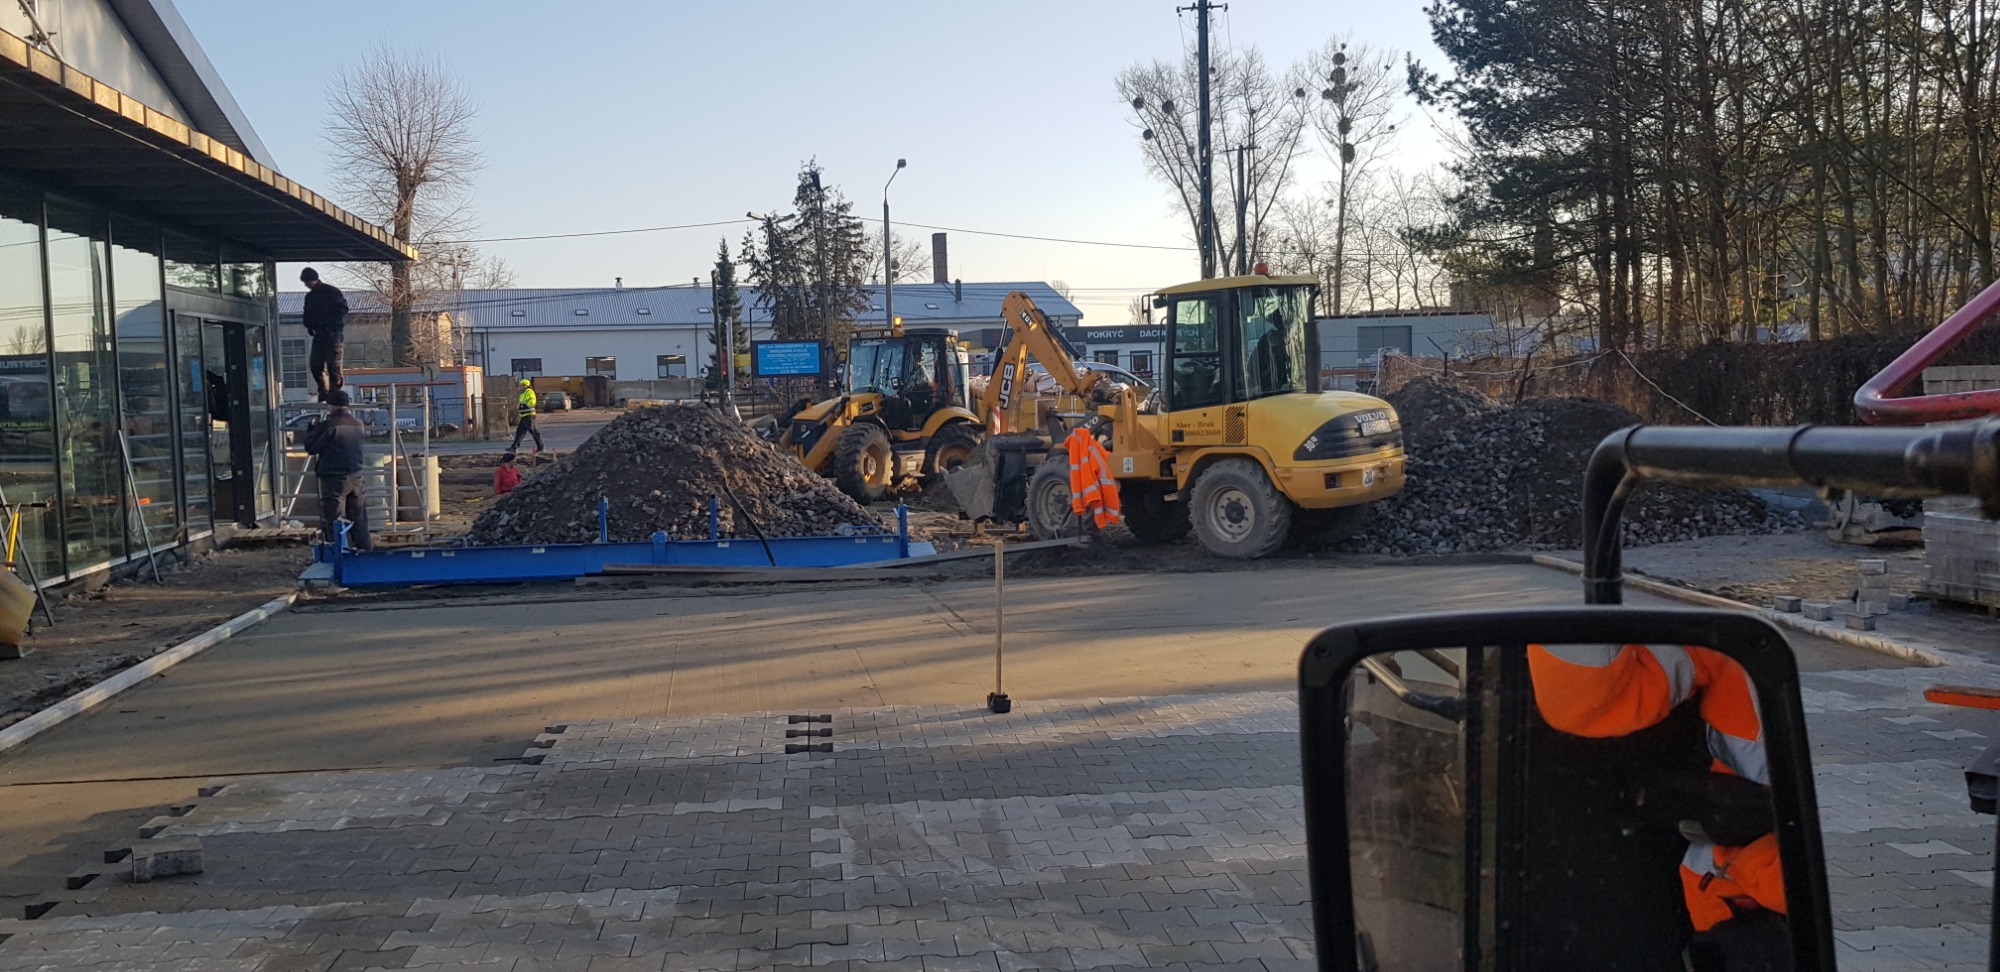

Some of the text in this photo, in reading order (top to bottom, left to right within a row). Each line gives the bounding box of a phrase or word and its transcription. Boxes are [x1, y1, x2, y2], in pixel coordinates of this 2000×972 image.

[1087, 329, 1124, 338] POKRYĆ
[999, 363, 1015, 409] JCB
[1354, 411, 1386, 423] VOLVO
[1364, 470, 1373, 484] 20
